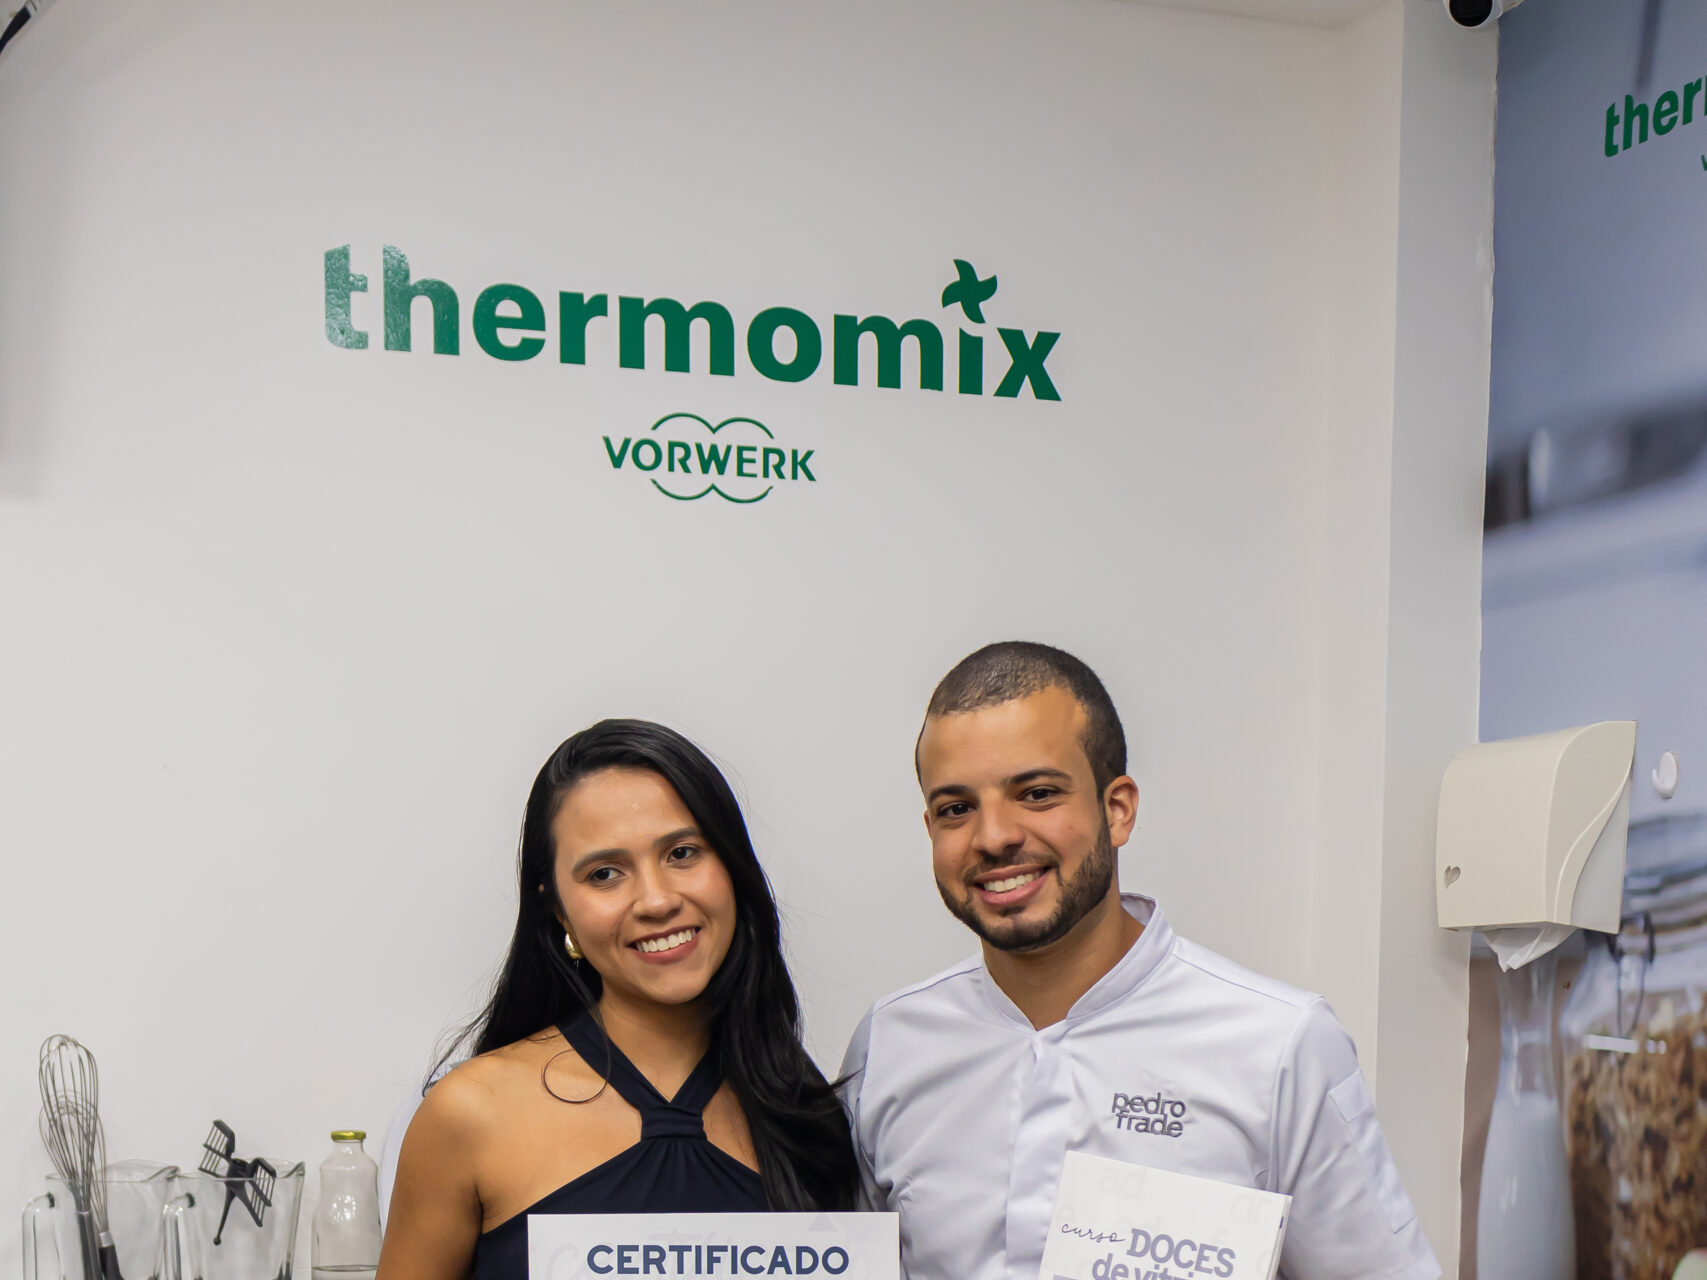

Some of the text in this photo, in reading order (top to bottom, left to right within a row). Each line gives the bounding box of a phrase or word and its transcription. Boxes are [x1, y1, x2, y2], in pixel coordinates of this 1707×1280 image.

[1604, 74, 1707, 158] ther
[322, 243, 1062, 402] thermomix
[601, 434, 817, 483] VORWERK
[1111, 1092, 1187, 1118] pedro
[1115, 1109, 1184, 1138] frade
[586, 1244, 850, 1276] CERTIFICADO
[1061, 1223, 1237, 1279] curso DOCES
